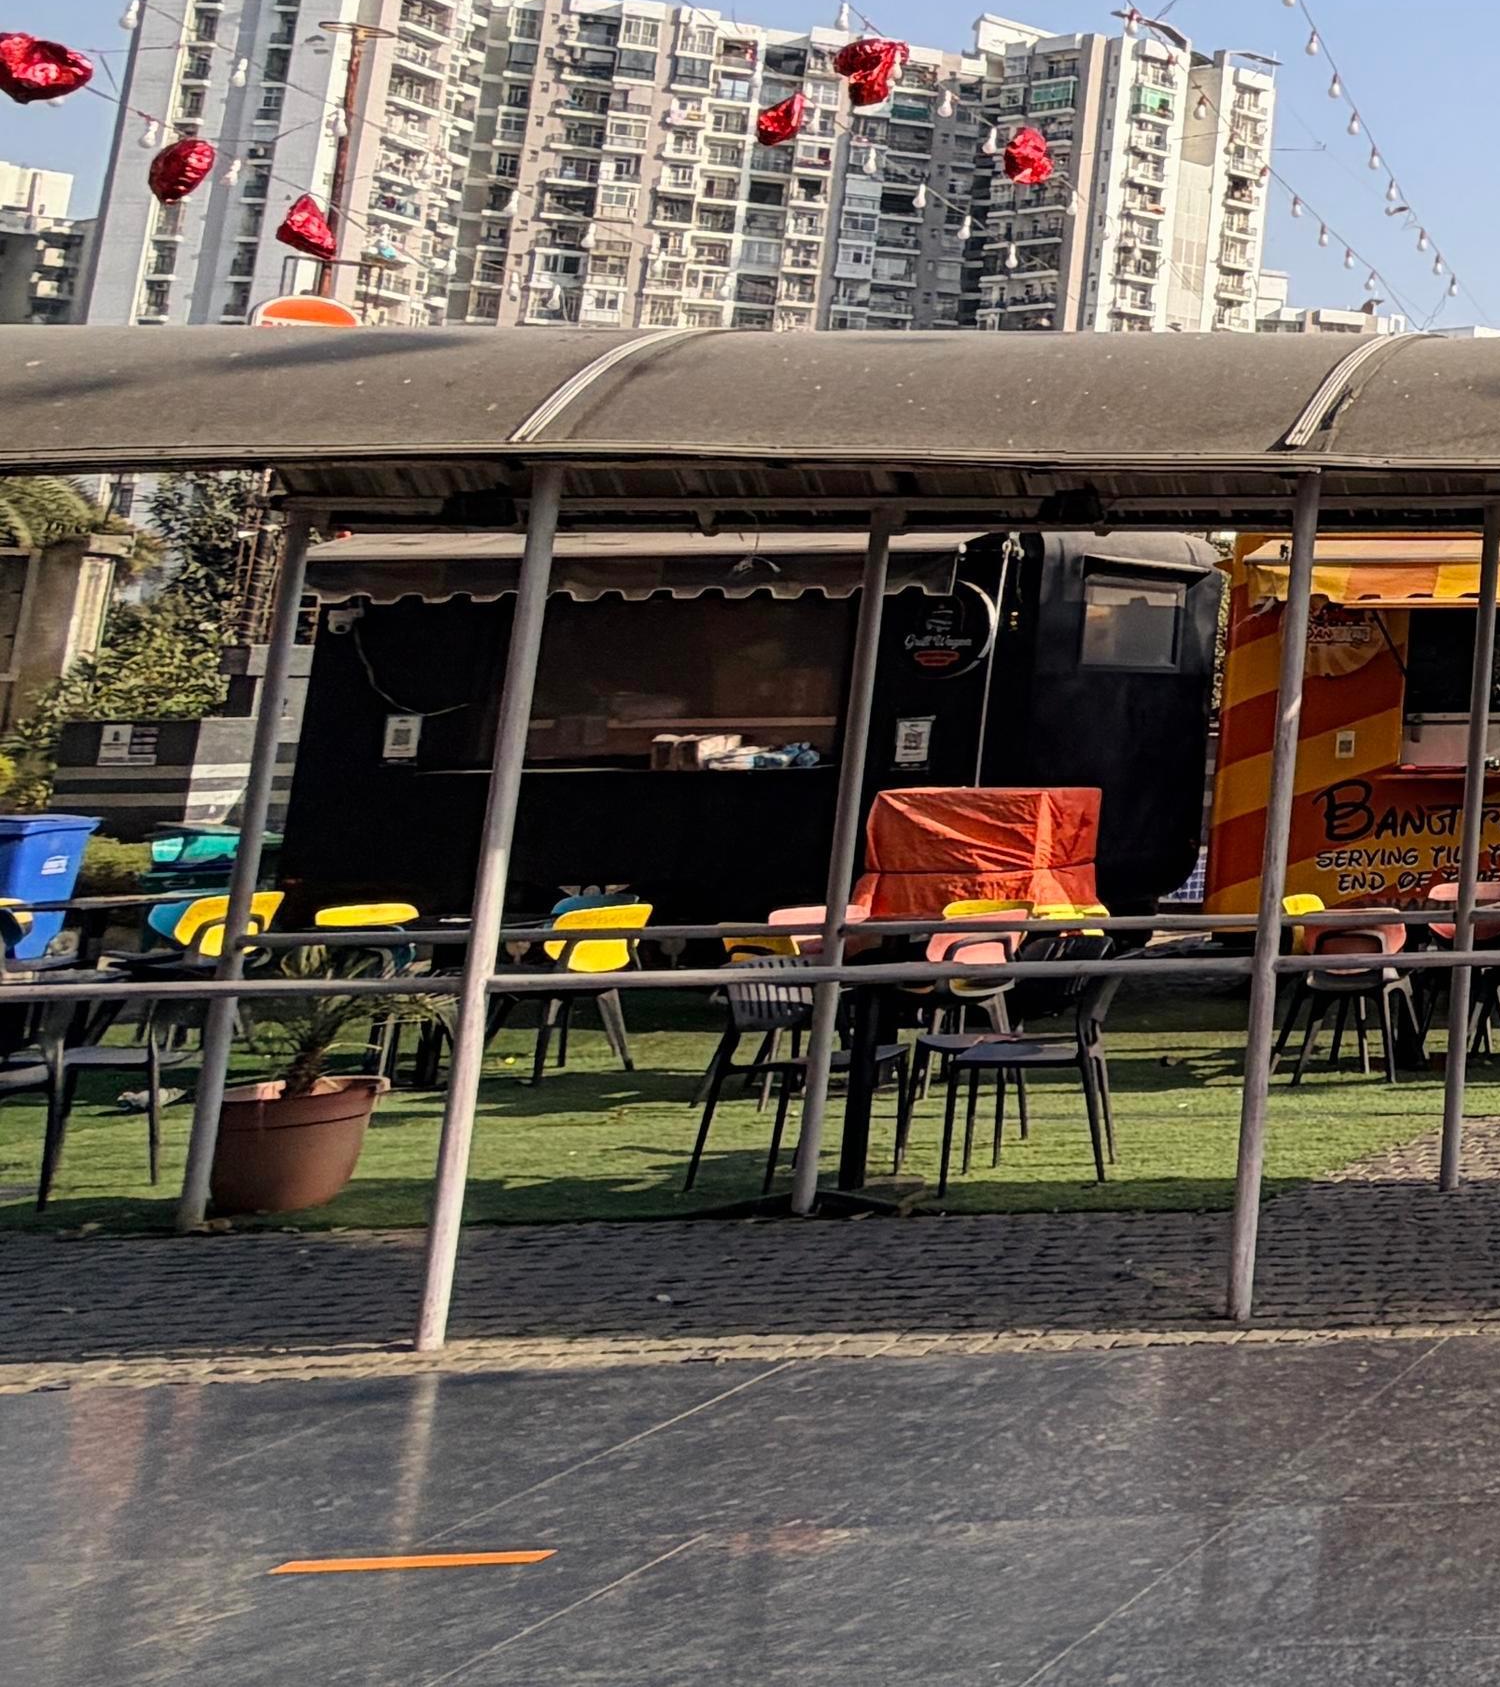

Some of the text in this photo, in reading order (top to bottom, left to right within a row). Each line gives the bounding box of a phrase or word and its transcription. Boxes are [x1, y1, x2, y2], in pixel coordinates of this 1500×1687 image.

[1316, 847, 1420, 870] SERVING
[1337, 871, 1386, 895] END
[1397, 869, 1432, 893] OF
